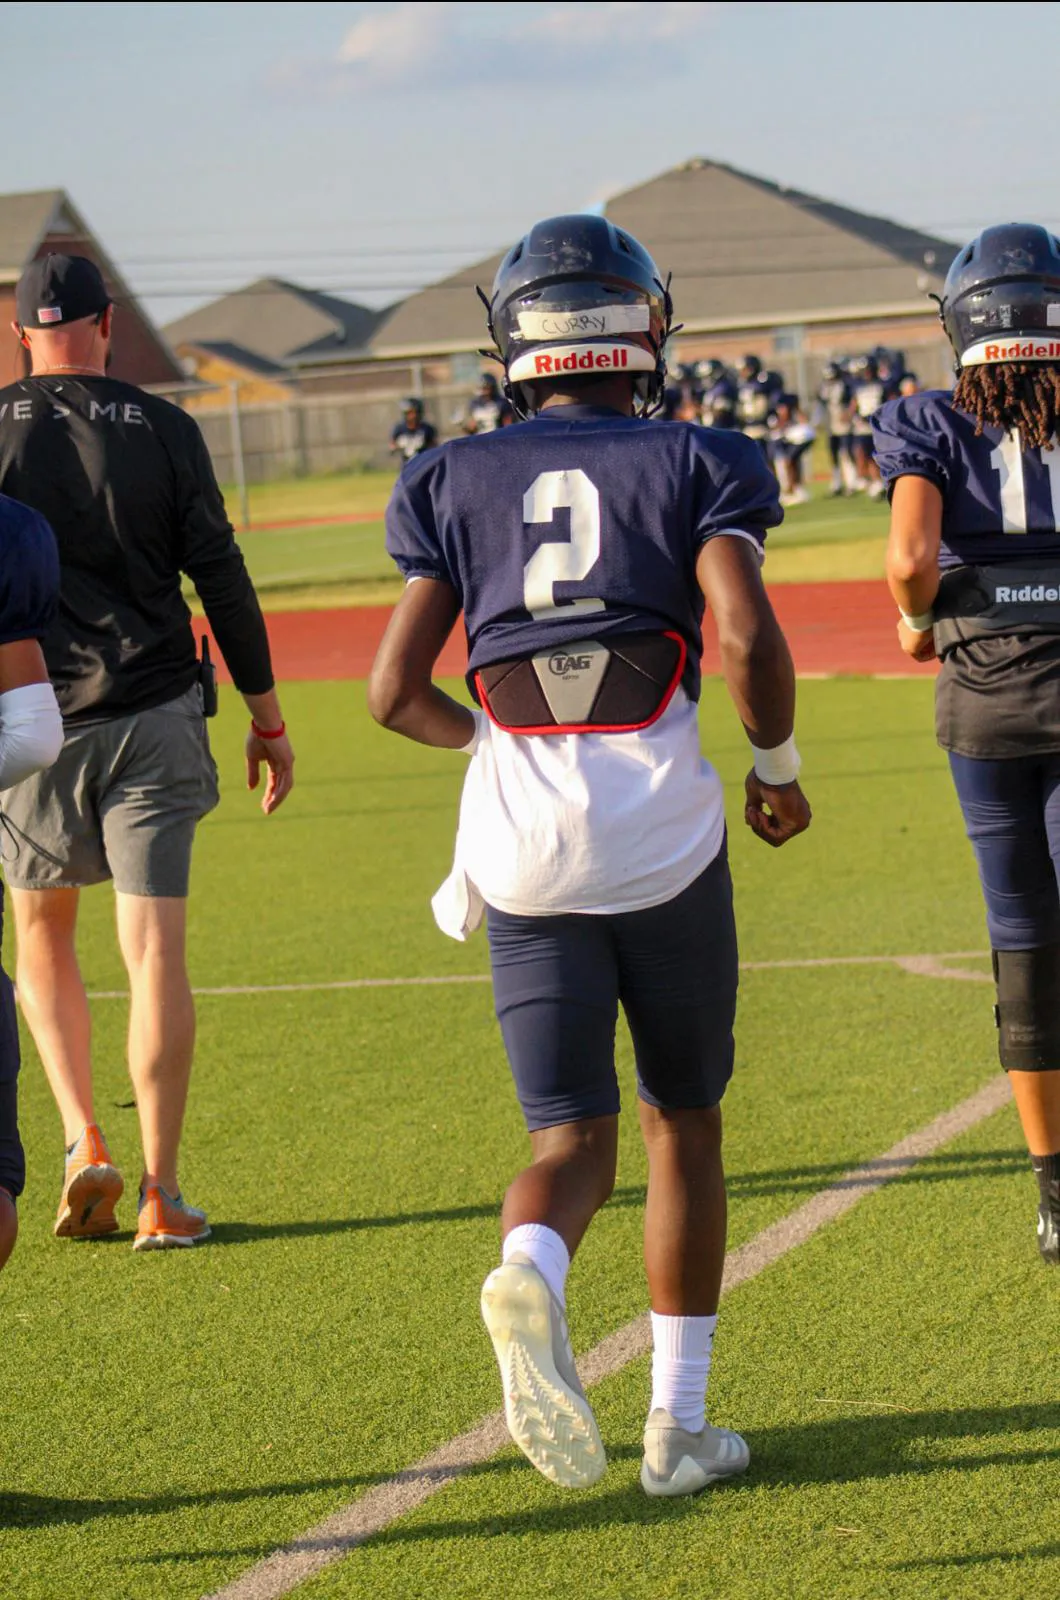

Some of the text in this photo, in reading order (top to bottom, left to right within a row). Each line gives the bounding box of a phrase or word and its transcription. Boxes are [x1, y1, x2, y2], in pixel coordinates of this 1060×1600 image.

[542, 315, 606, 334] CURRY
[534, 349, 627, 374] Riddell
[984, 343, 1060, 360] Riddell
[89, 401, 143, 424] ME
[523, 468, 606, 621] 2
[551, 654, 593, 672] TAG
